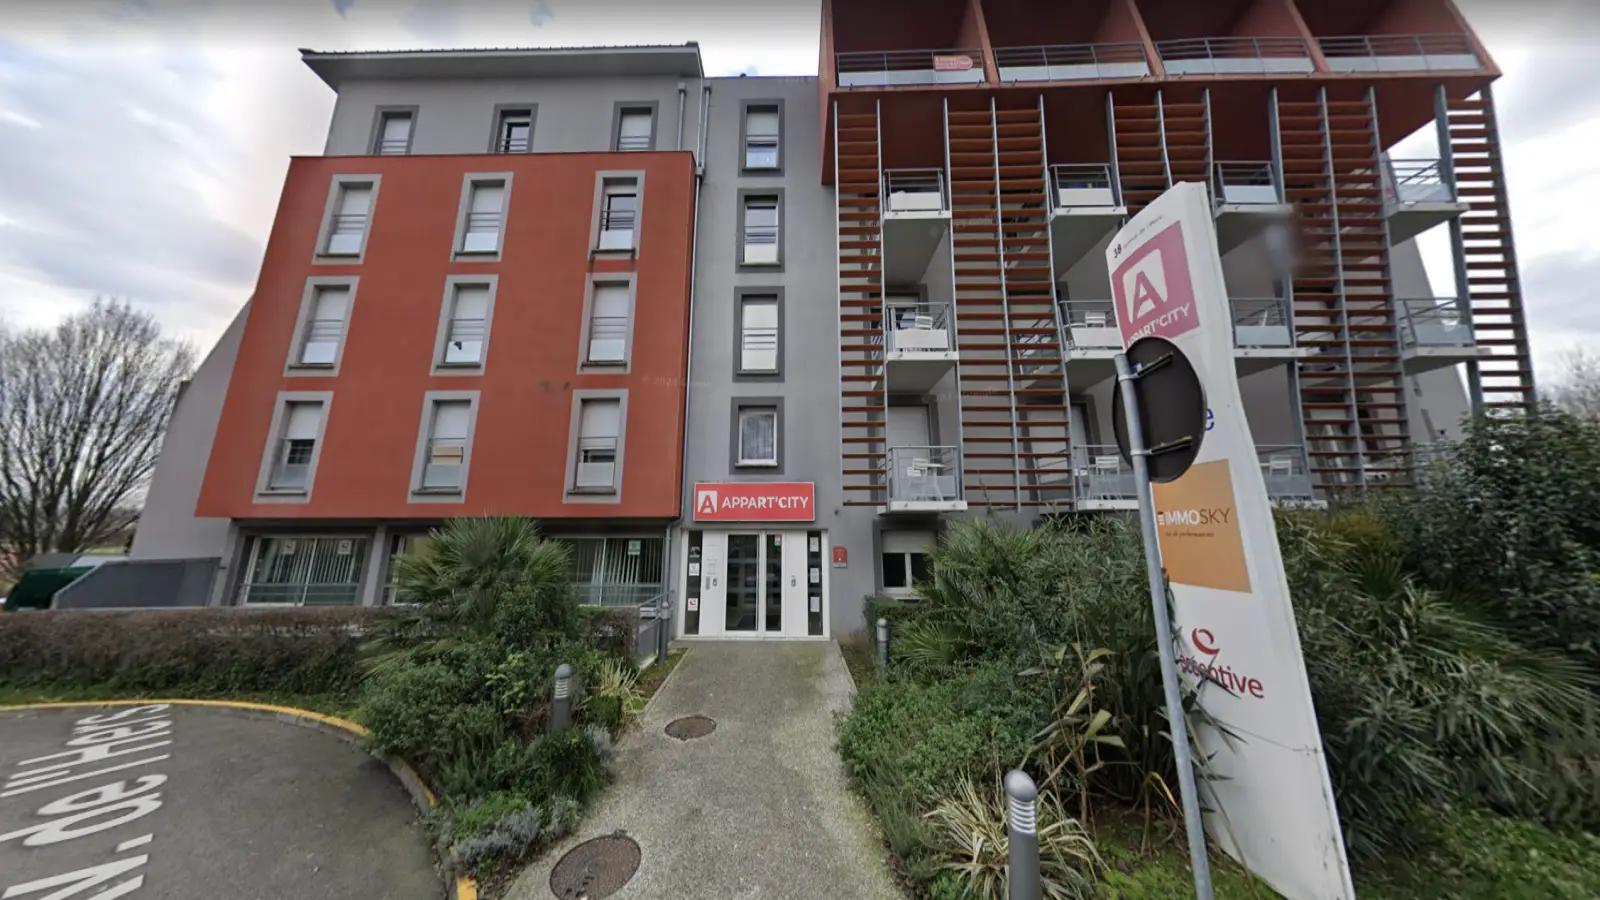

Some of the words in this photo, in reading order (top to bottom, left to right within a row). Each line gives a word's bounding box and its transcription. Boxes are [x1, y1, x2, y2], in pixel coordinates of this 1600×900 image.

[721, 496, 809, 509] APPART'CITY
[0, 703, 173, 799] l'Hers
[0, 774, 168, 847] de
